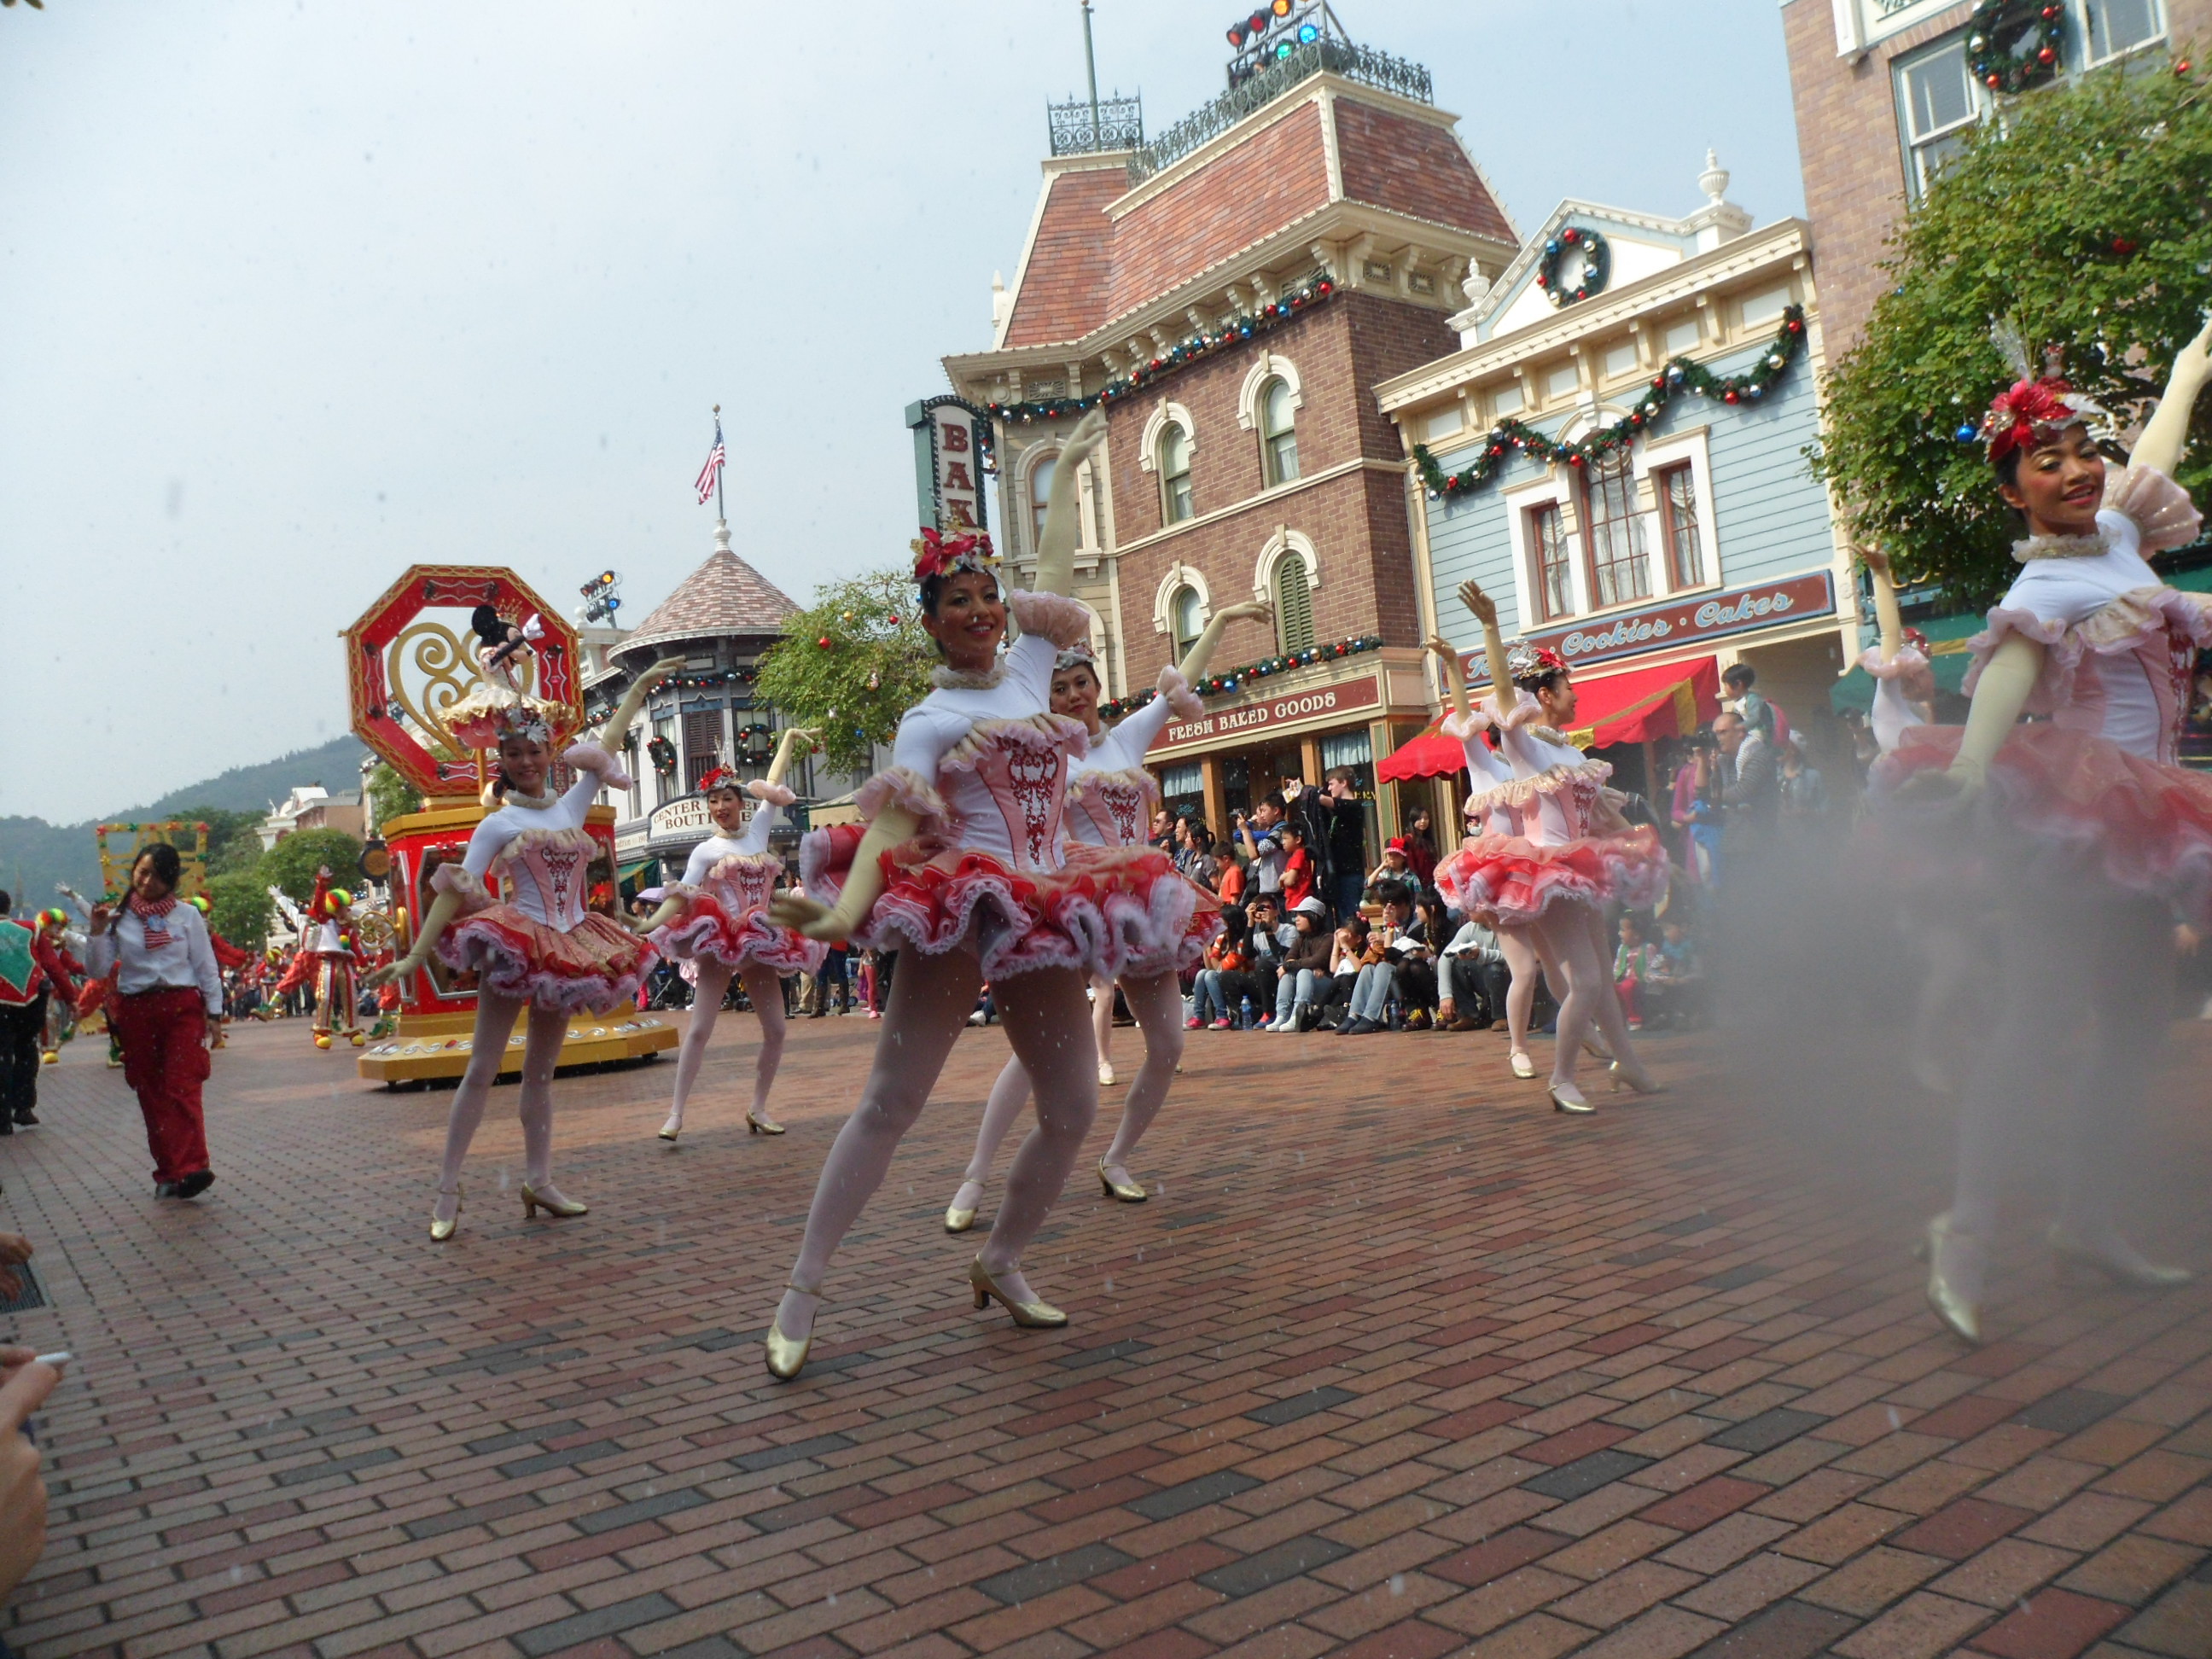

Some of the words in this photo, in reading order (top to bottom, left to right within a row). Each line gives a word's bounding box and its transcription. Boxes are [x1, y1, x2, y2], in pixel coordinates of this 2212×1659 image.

[940, 422, 978, 527] BAK
[1561, 618, 1673, 656] Cookies
[1694, 592, 1794, 627] Cakes
[1168, 719, 1214, 742] FRESH
[1219, 707, 1268, 731] BAKED
[1274, 692, 1336, 718] GOODS
[653, 800, 702, 824] CENTER
[665, 812, 753, 830] BOUTIE
